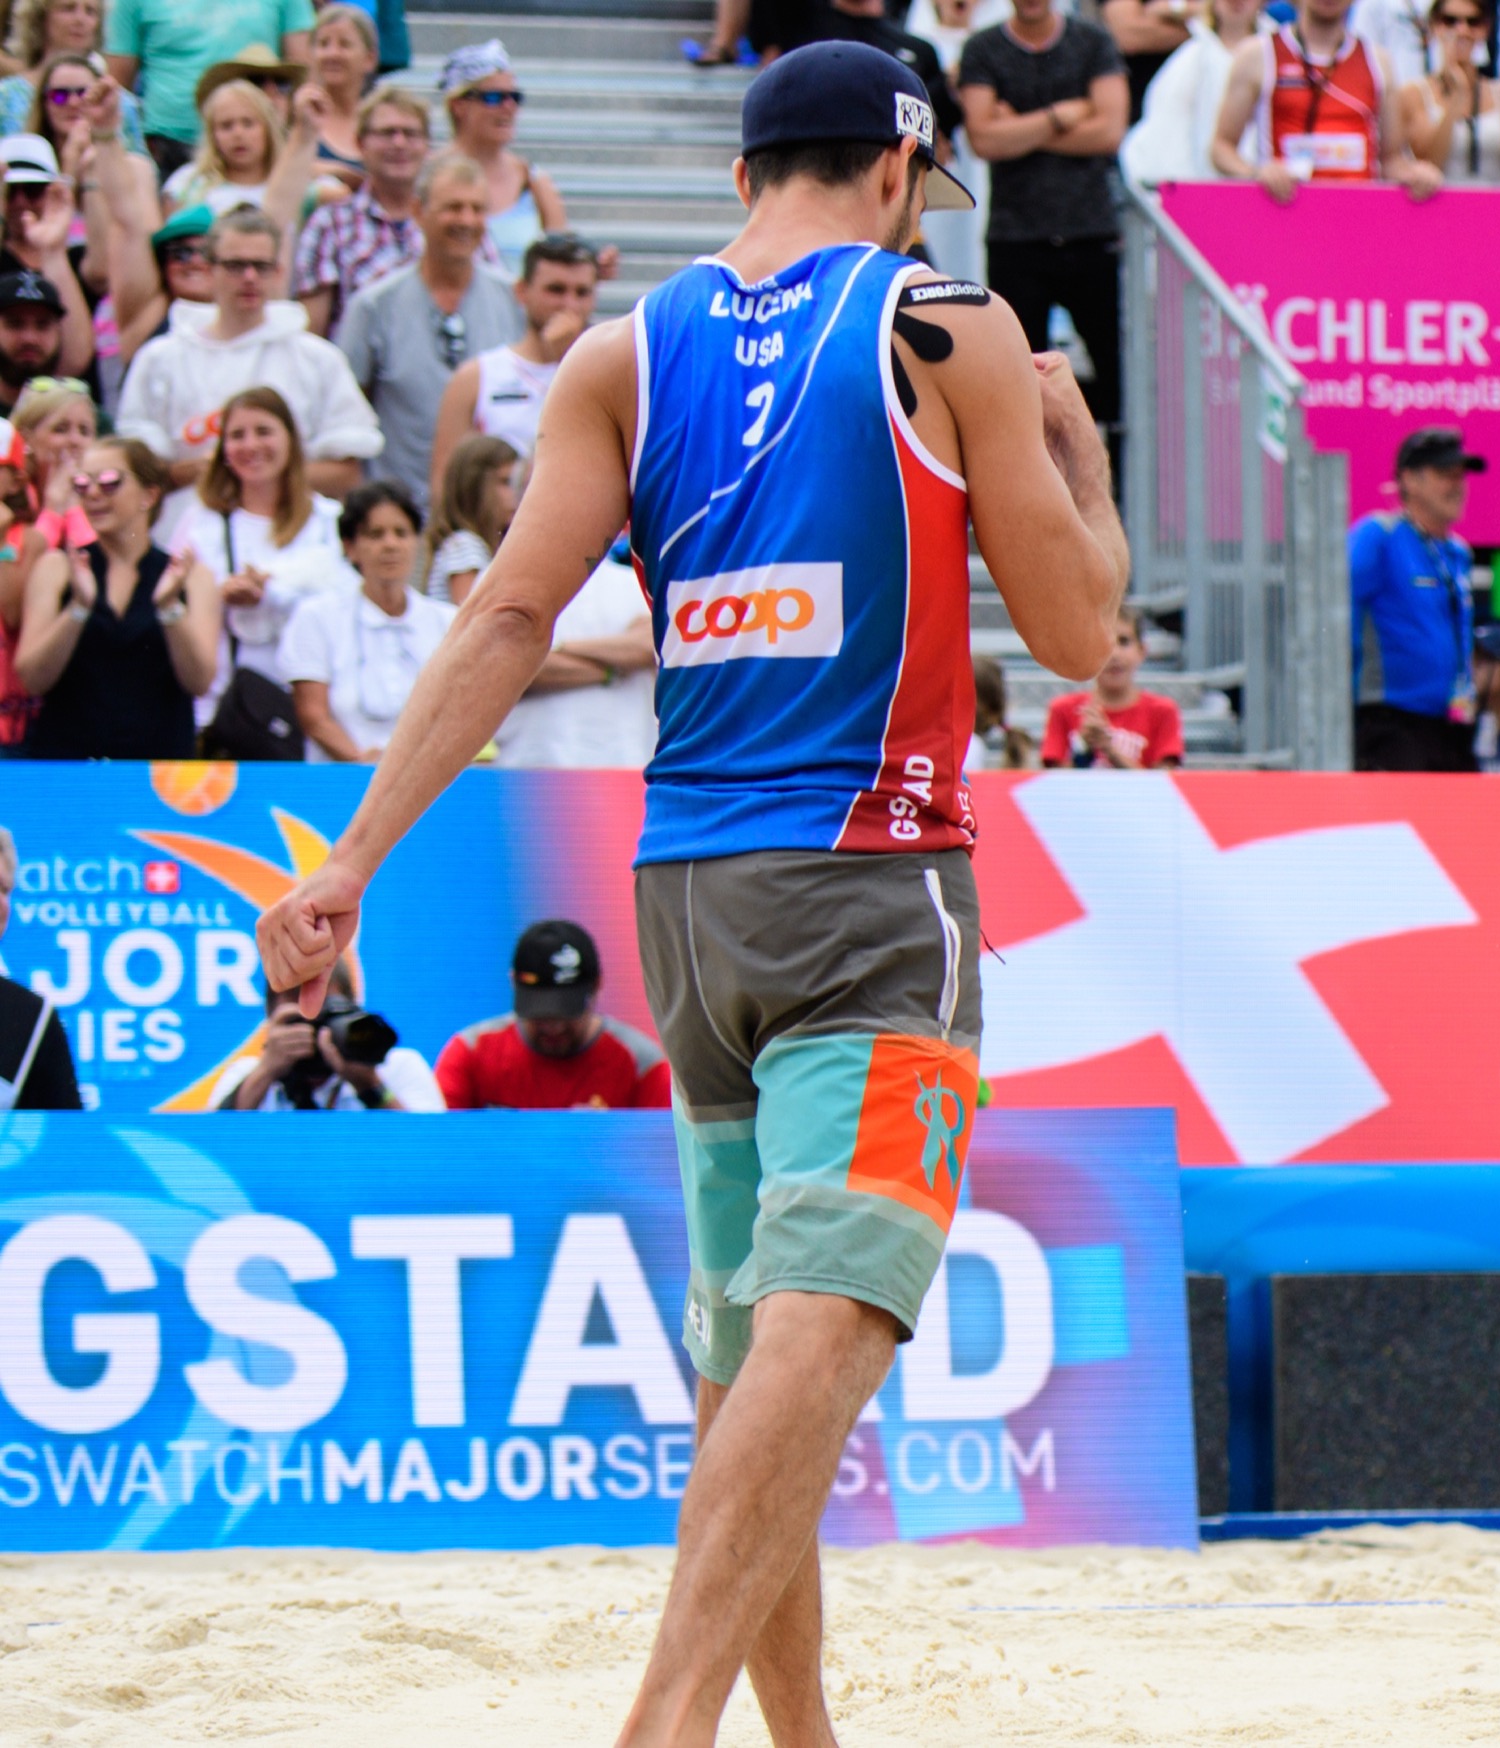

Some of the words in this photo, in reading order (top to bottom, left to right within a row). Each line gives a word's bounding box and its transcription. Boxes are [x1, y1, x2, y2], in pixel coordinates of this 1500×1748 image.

[709, 281, 813, 324] LUCENA
[735, 330, 784, 368] USA
[742, 381, 775, 447] 2
[674, 587, 815, 645] coop
[16, 856, 141, 894] atch
[14, 901, 232, 927] VOLLEYBALL
[30, 928, 264, 1007] JOR
